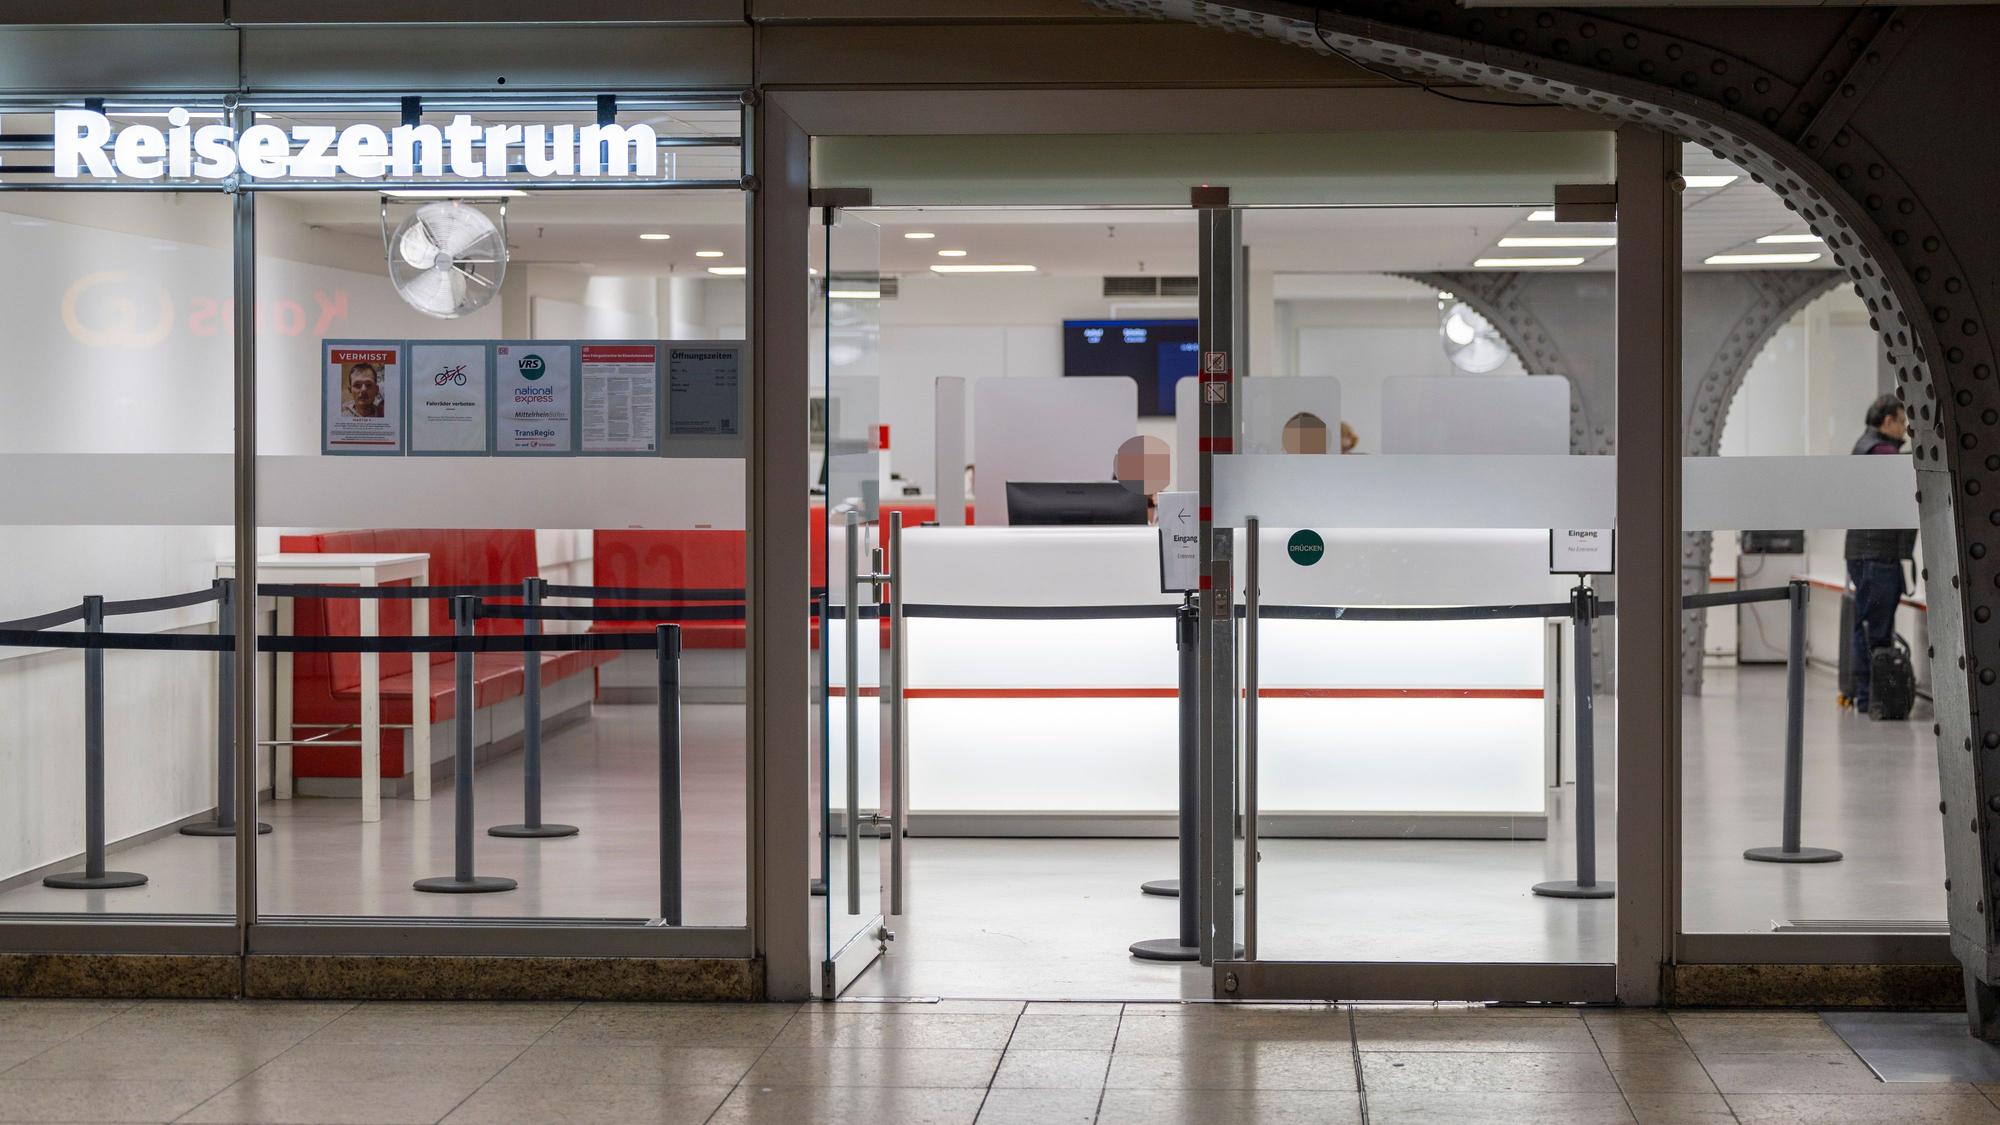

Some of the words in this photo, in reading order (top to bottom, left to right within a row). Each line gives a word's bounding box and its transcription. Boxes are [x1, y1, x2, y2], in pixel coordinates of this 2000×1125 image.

[54, 107, 657, 179] Reisezentrum
[339, 353, 388, 361] VERMISST
[671, 351, 732, 361] Öffnungszeiten
[518, 360, 539, 369] VRS
[515, 386, 553, 395] national
[515, 395, 553, 404] express
[515, 429, 555, 437] TransRegio
[1568, 529, 1598, 538] Eingang
[1173, 534, 1198, 543] Eingang
[1289, 543, 1323, 552] DRÜCKEN
